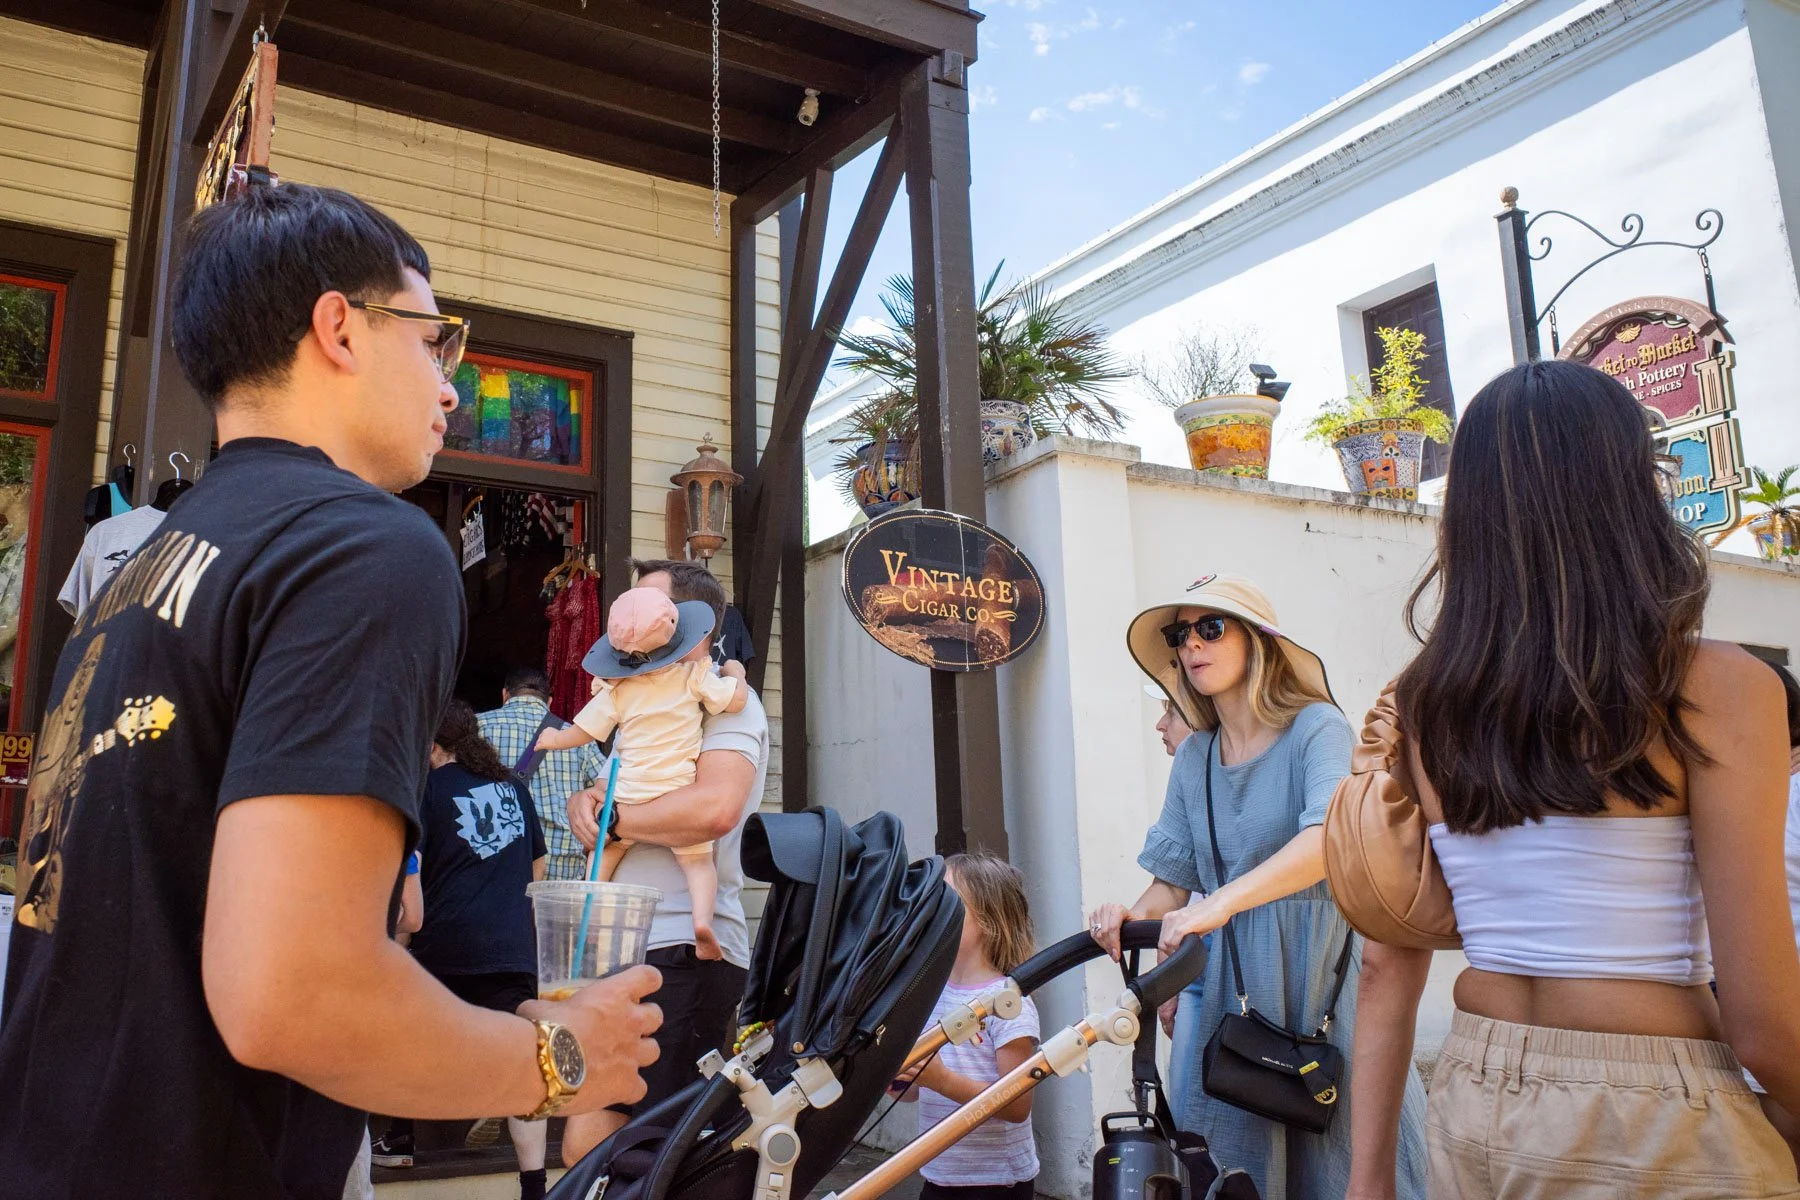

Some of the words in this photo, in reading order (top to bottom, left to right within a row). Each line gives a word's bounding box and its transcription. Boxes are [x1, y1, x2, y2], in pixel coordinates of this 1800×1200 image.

[1637, 330, 1696, 371] Market
[1638, 362, 1687, 387] Pottery
[1651, 379, 1682, 396] SPICES
[880, 549, 1014, 604] VINTAGE
[902, 589, 961, 619] CIGAR
